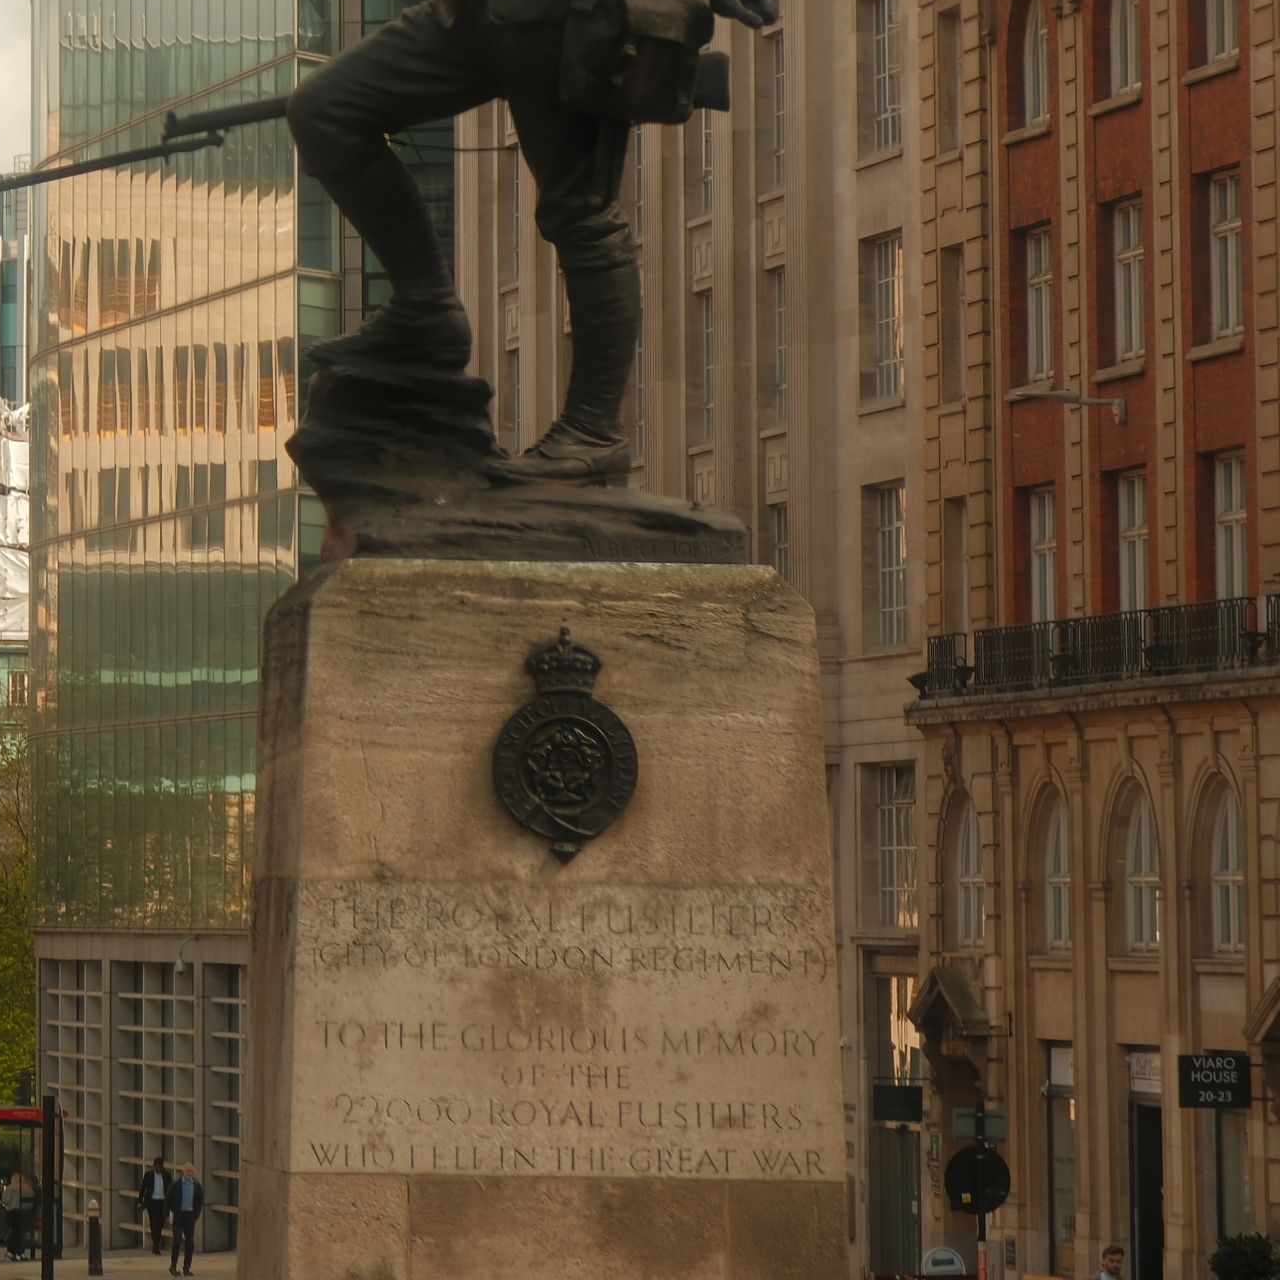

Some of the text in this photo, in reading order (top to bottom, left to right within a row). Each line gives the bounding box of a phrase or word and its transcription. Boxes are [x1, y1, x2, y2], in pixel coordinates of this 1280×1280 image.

[321, 898, 800, 936] THE ROYAL FUSILIERS
[464, 944, 613, 970] LONDON
[630, 946, 827, 984] REGIMENT)
[316, 1019, 824, 1057] TO THE GLORIOUS MEMORY
[501, 1064, 630, 1089] OF THE
[1191, 1071, 1238, 1083] HOUSE
[1192, 1057, 1236, 1070] VIARO
[335, 1093, 803, 1131] 22000 ROYAL FUSILIERS
[1198, 1091, 1232, 1103] 20-23
[309, 1142, 394, 1169] WHO
[499, 1145, 536, 1170] IN
[549, 1146, 615, 1171] THE
[629, 1147, 738, 1174] GREAT
[753, 1149, 824, 1176] WAR
